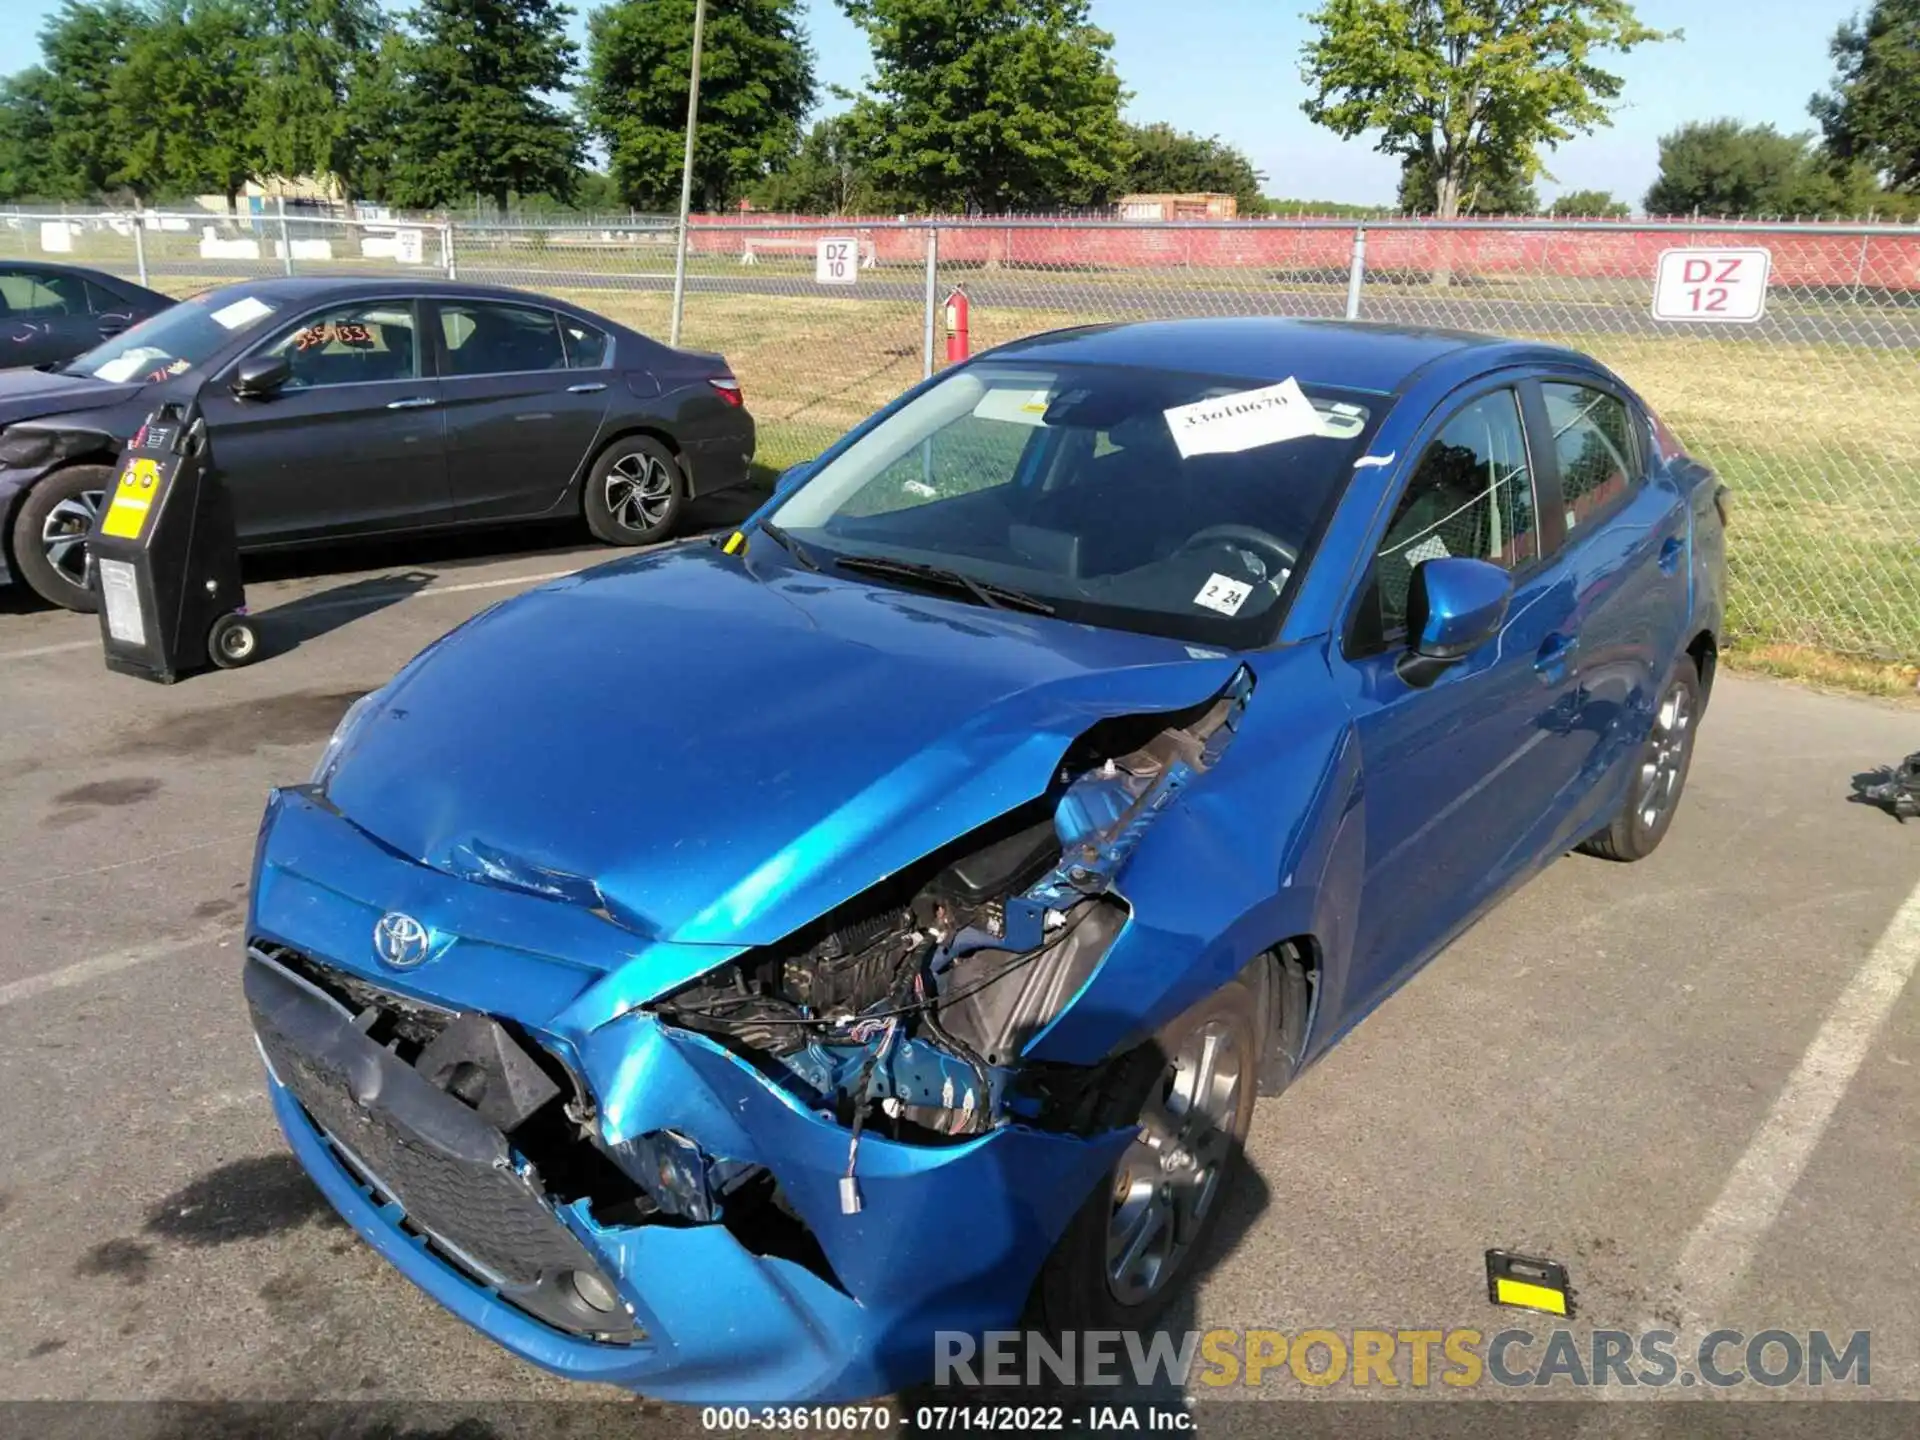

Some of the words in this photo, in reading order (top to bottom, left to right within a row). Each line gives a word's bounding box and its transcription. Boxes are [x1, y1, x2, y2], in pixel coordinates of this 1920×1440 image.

[826, 244, 848, 260] DZ
[829, 261, 845, 278] 10
[1683, 258, 1743, 284] DZ
[1687, 287, 1728, 312] 12
[1206, 585, 1219, 598] 2
[1222, 590, 1242, 607] 24
